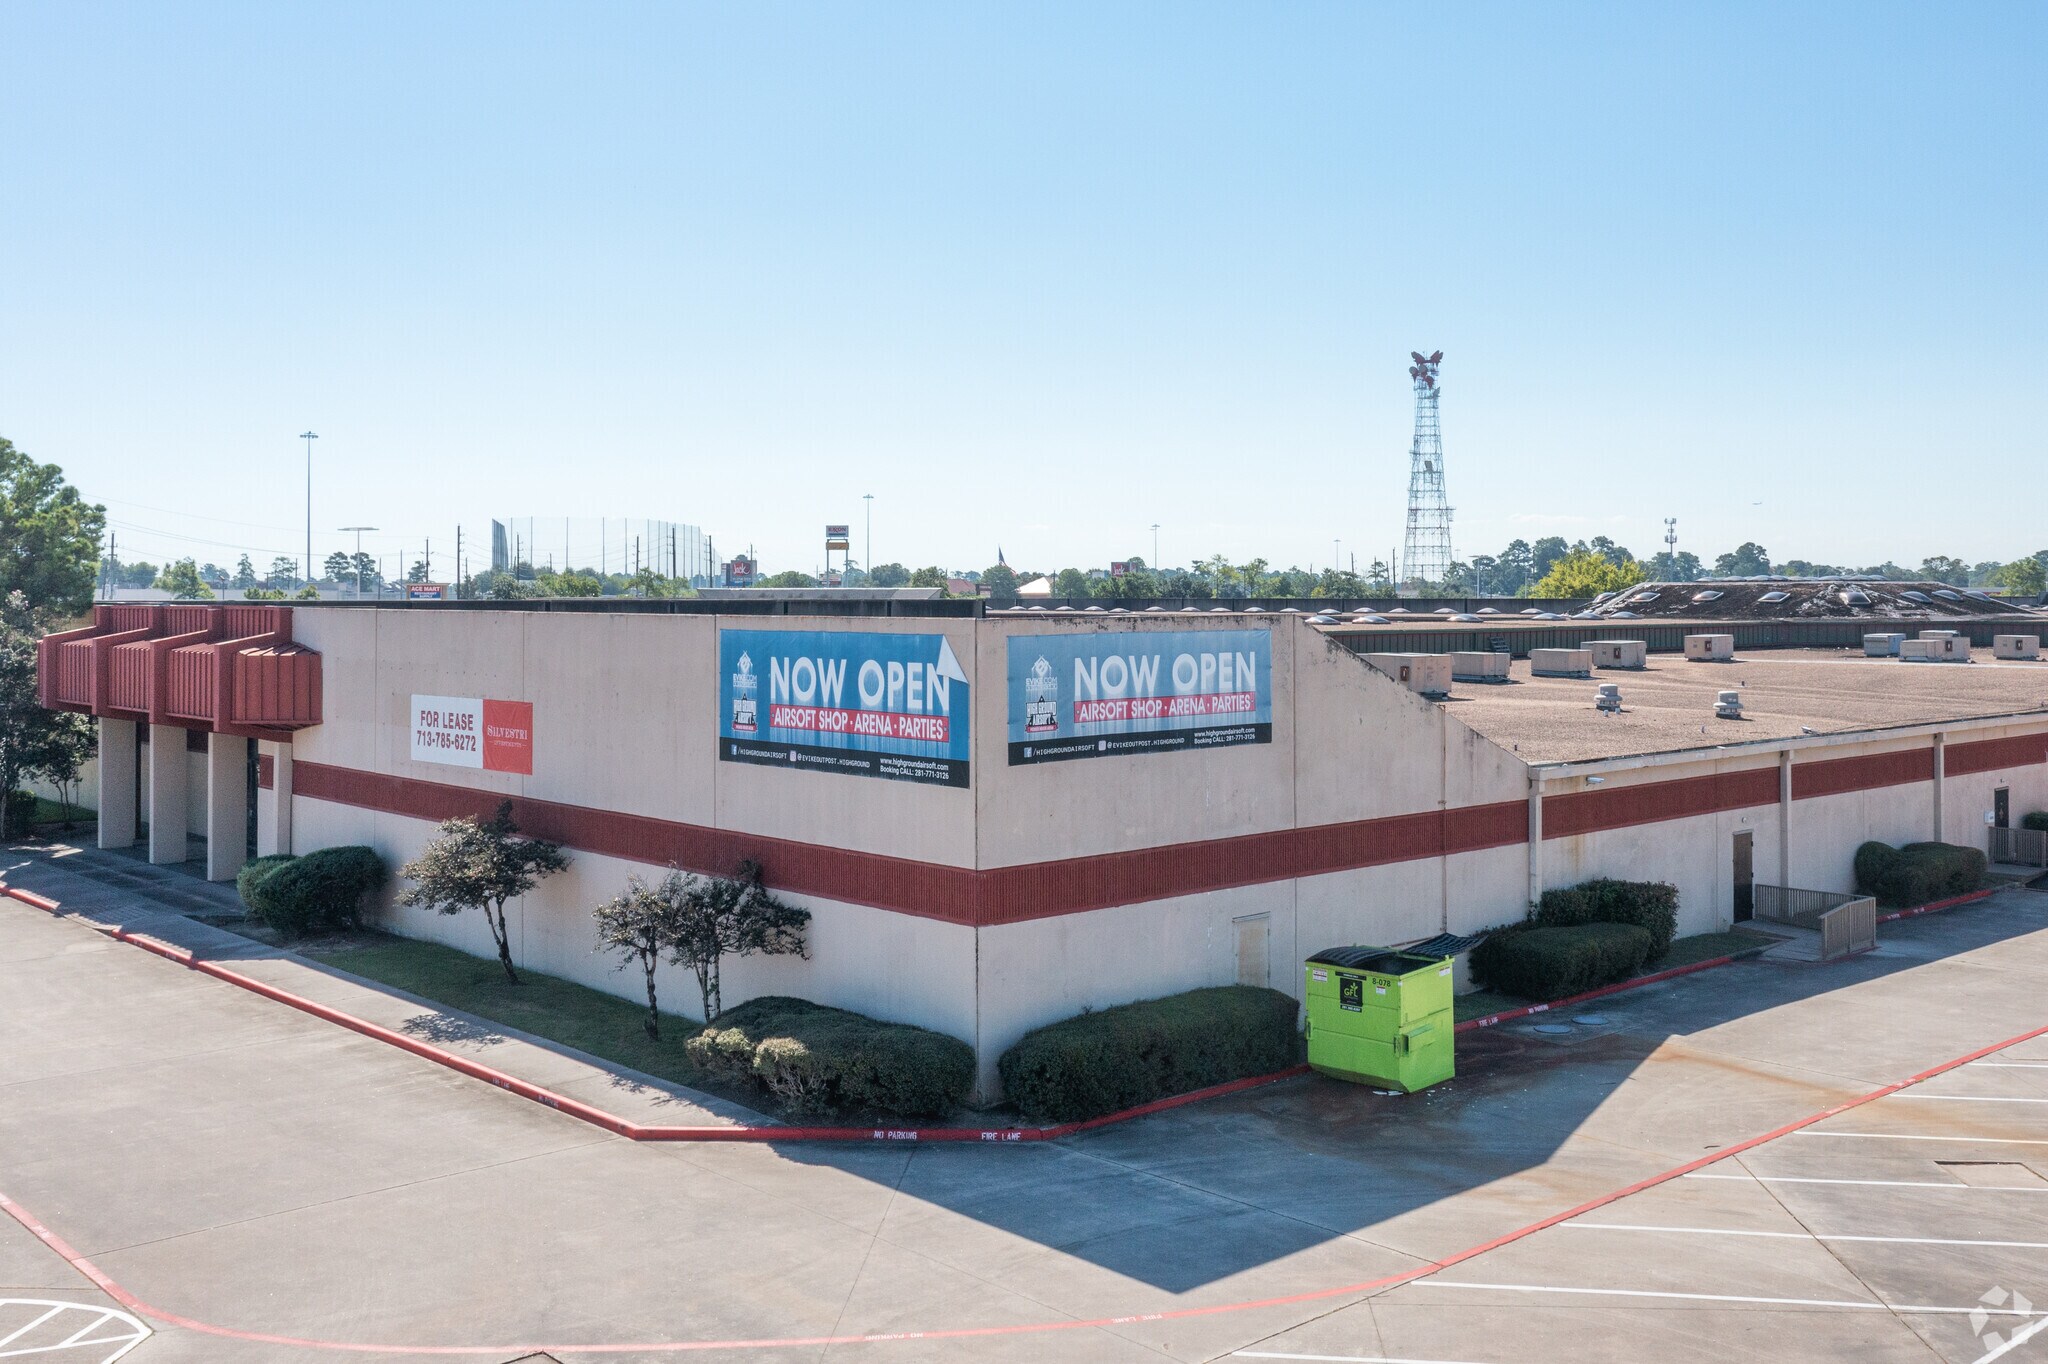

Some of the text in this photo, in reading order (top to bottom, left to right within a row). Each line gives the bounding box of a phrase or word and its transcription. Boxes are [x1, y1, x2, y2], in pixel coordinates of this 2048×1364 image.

[770, 656, 950, 711] NOW OPEN
[1074, 651, 1256, 700] NOW OPEN
[1079, 694, 1251, 722] AIRSOFT SHOP ARENA PARTIES
[420, 710, 474, 731] FOR LEASE
[774, 707, 943, 740] AIRSOFT SHOP ARENA PARTIES
[417, 730, 476, 752] 713-785-6272
[1194, 727, 1256, 738] www.highgroundairsoft.com
[880, 758, 949, 771] www.highgroundairsoft.com
[880, 765, 899, 776] Booking
[1371, 977, 1392, 988] 8-078
[873, 1130, 917, 1140] NO PARKING
[981, 1132, 1022, 1141] FIRE LANE
